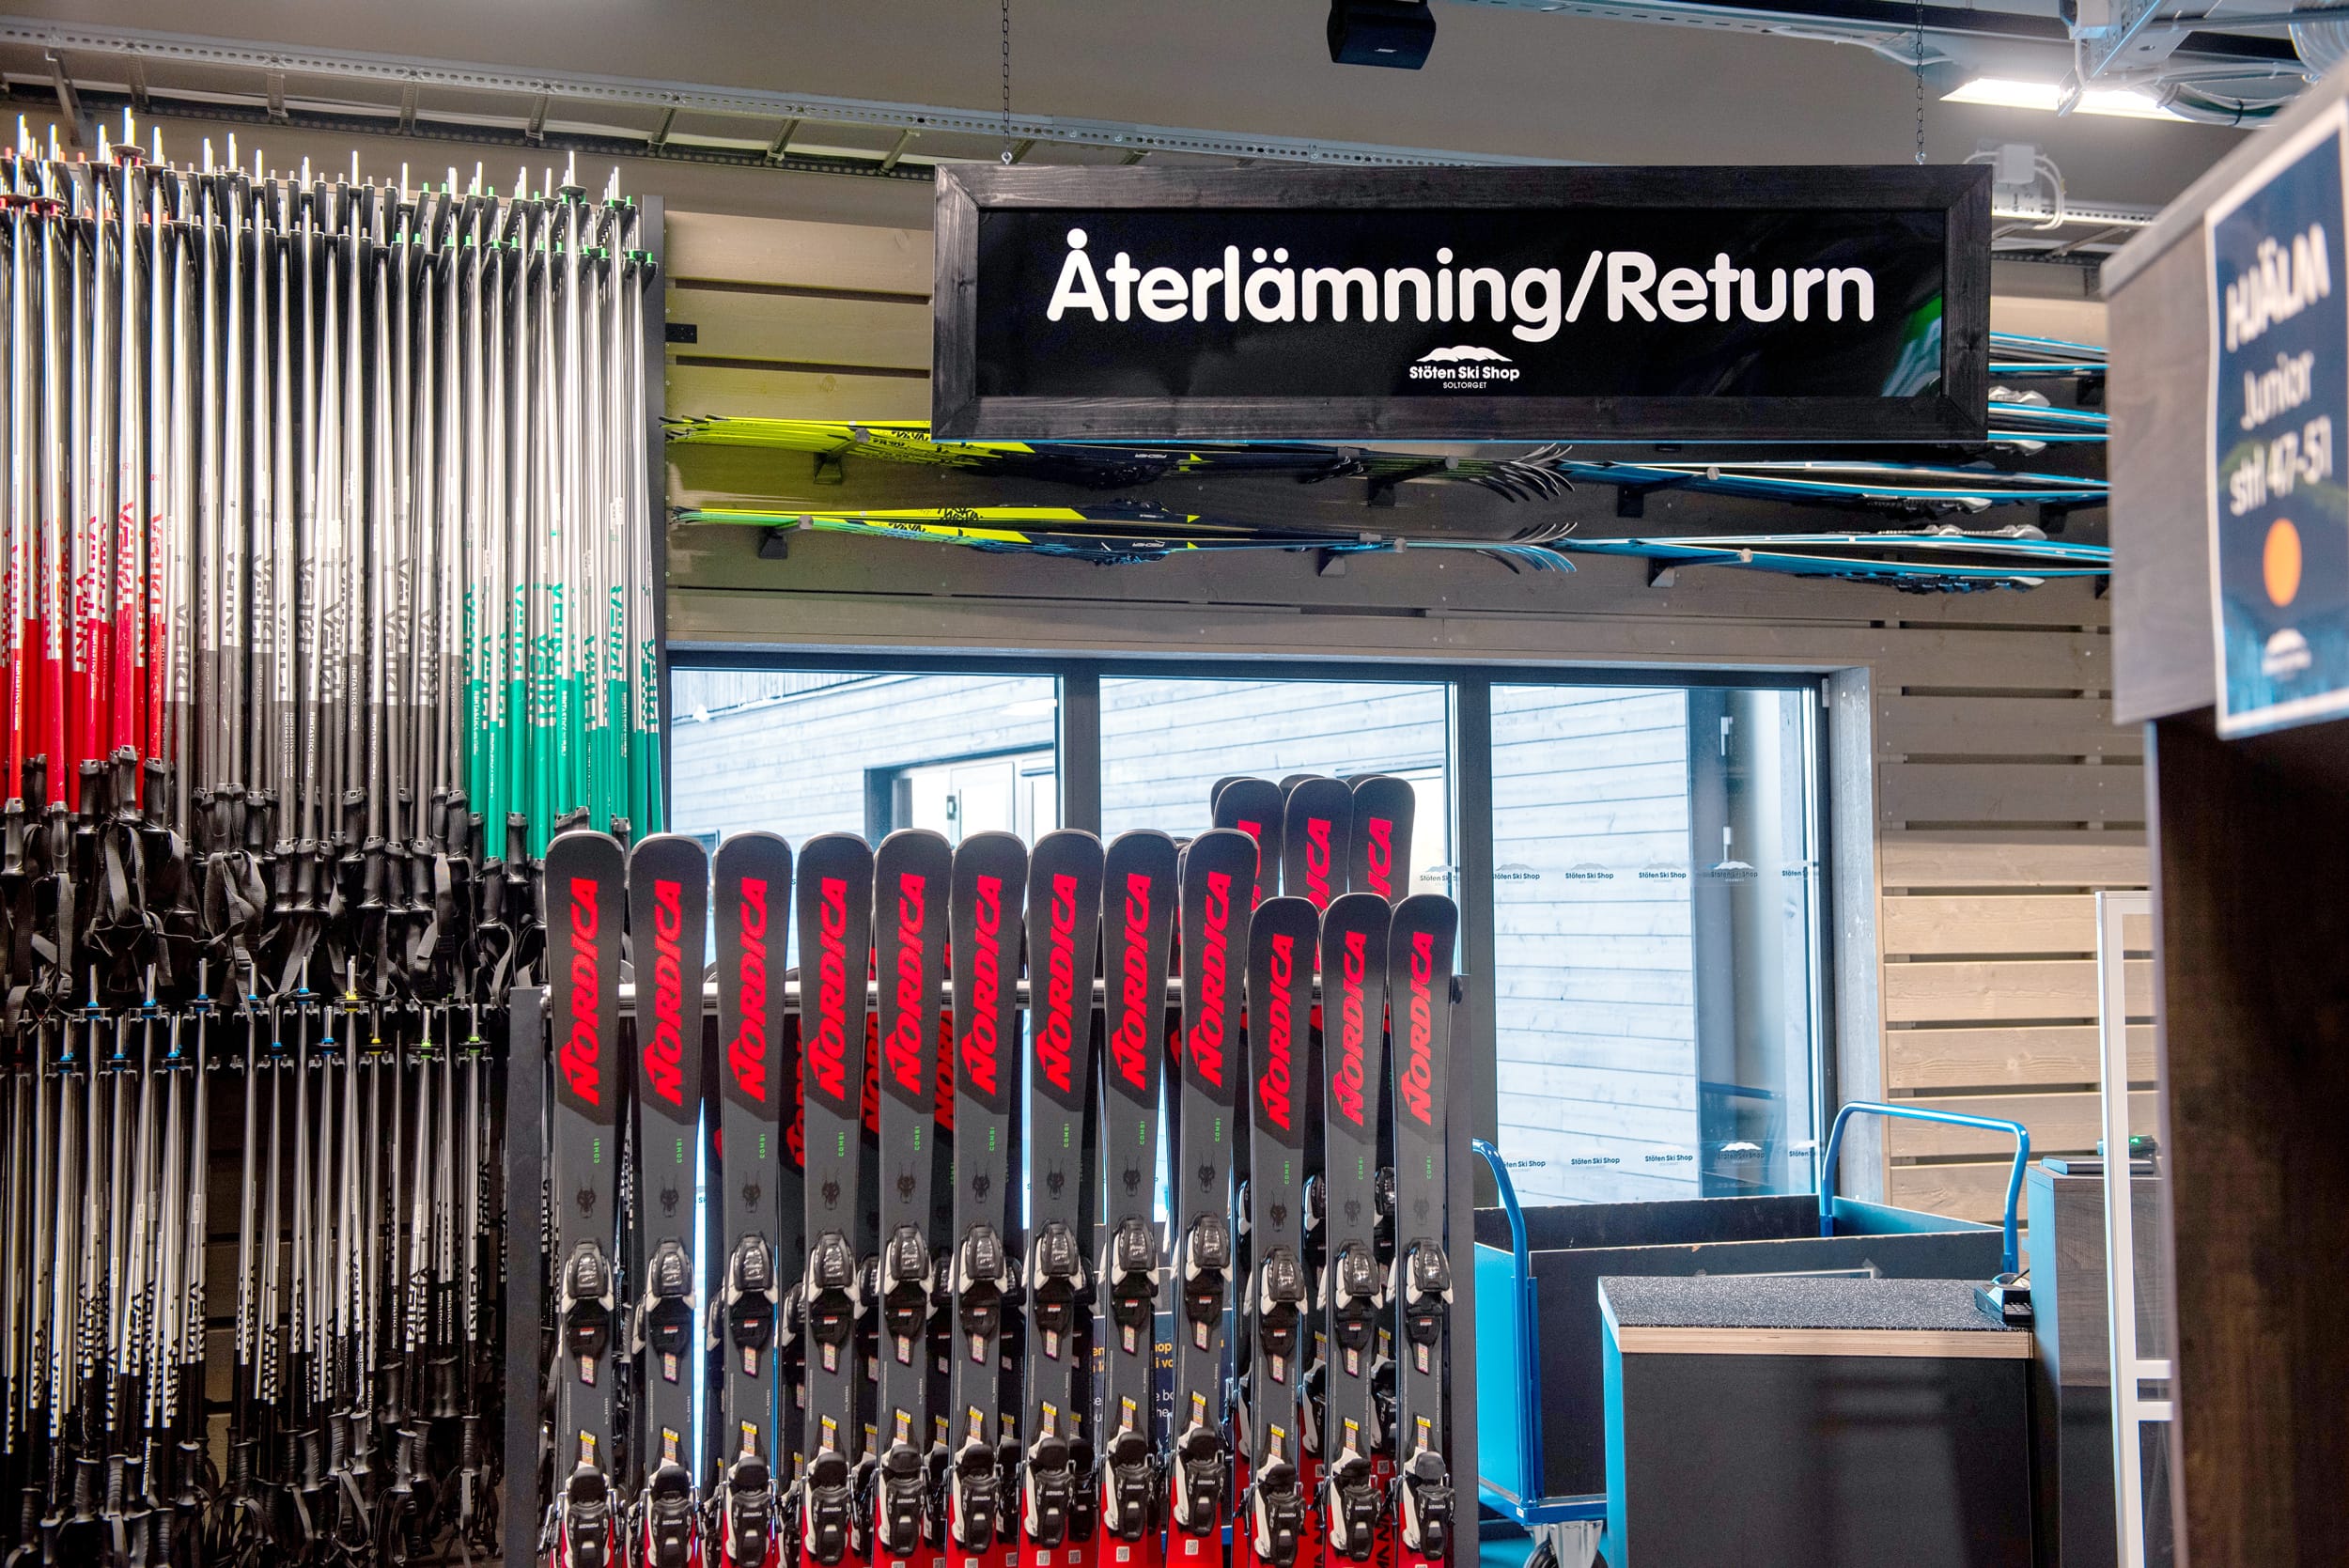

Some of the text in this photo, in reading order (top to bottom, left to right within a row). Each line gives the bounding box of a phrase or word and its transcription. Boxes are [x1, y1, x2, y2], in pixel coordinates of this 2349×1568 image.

[1046, 227, 1875, 343] Återlämning/Return
[1408, 365, 1520, 381] Stöten Ski Shop
[2226, 222, 2330, 352] HJÄLM
[2241, 349, 2314, 431] Junior
[2267, 414, 2333, 500] 47-51
[1523, 872, 1541, 880] Shop
[1597, 872, 1614, 880] Shop
[1670, 871, 1688, 879] Shop
[560, 877, 599, 1105] NORDICA
[644, 879, 682, 1106] NORDICA
[728, 877, 767, 1102] NORDICA
[808, 877, 847, 1100] NORDICA
[885, 874, 925, 1094] NORDICA
[961, 876, 1002, 1094] NORDICA
[1036, 874, 1077, 1092] NORDICA
[1112, 874, 1150, 1090] NORDICA
[1190, 872, 1231, 1087] NORDICA
[1259, 934, 1293, 1130] NORDICA
[1333, 932, 1366, 1126] NORDICA
[1402, 932, 1433, 1124] NORDICA
[1593, 1157, 1603, 1165] Ski
[1603, 1157, 1620, 1165] Shop
[1676, 1154, 1693, 1162] Shop
